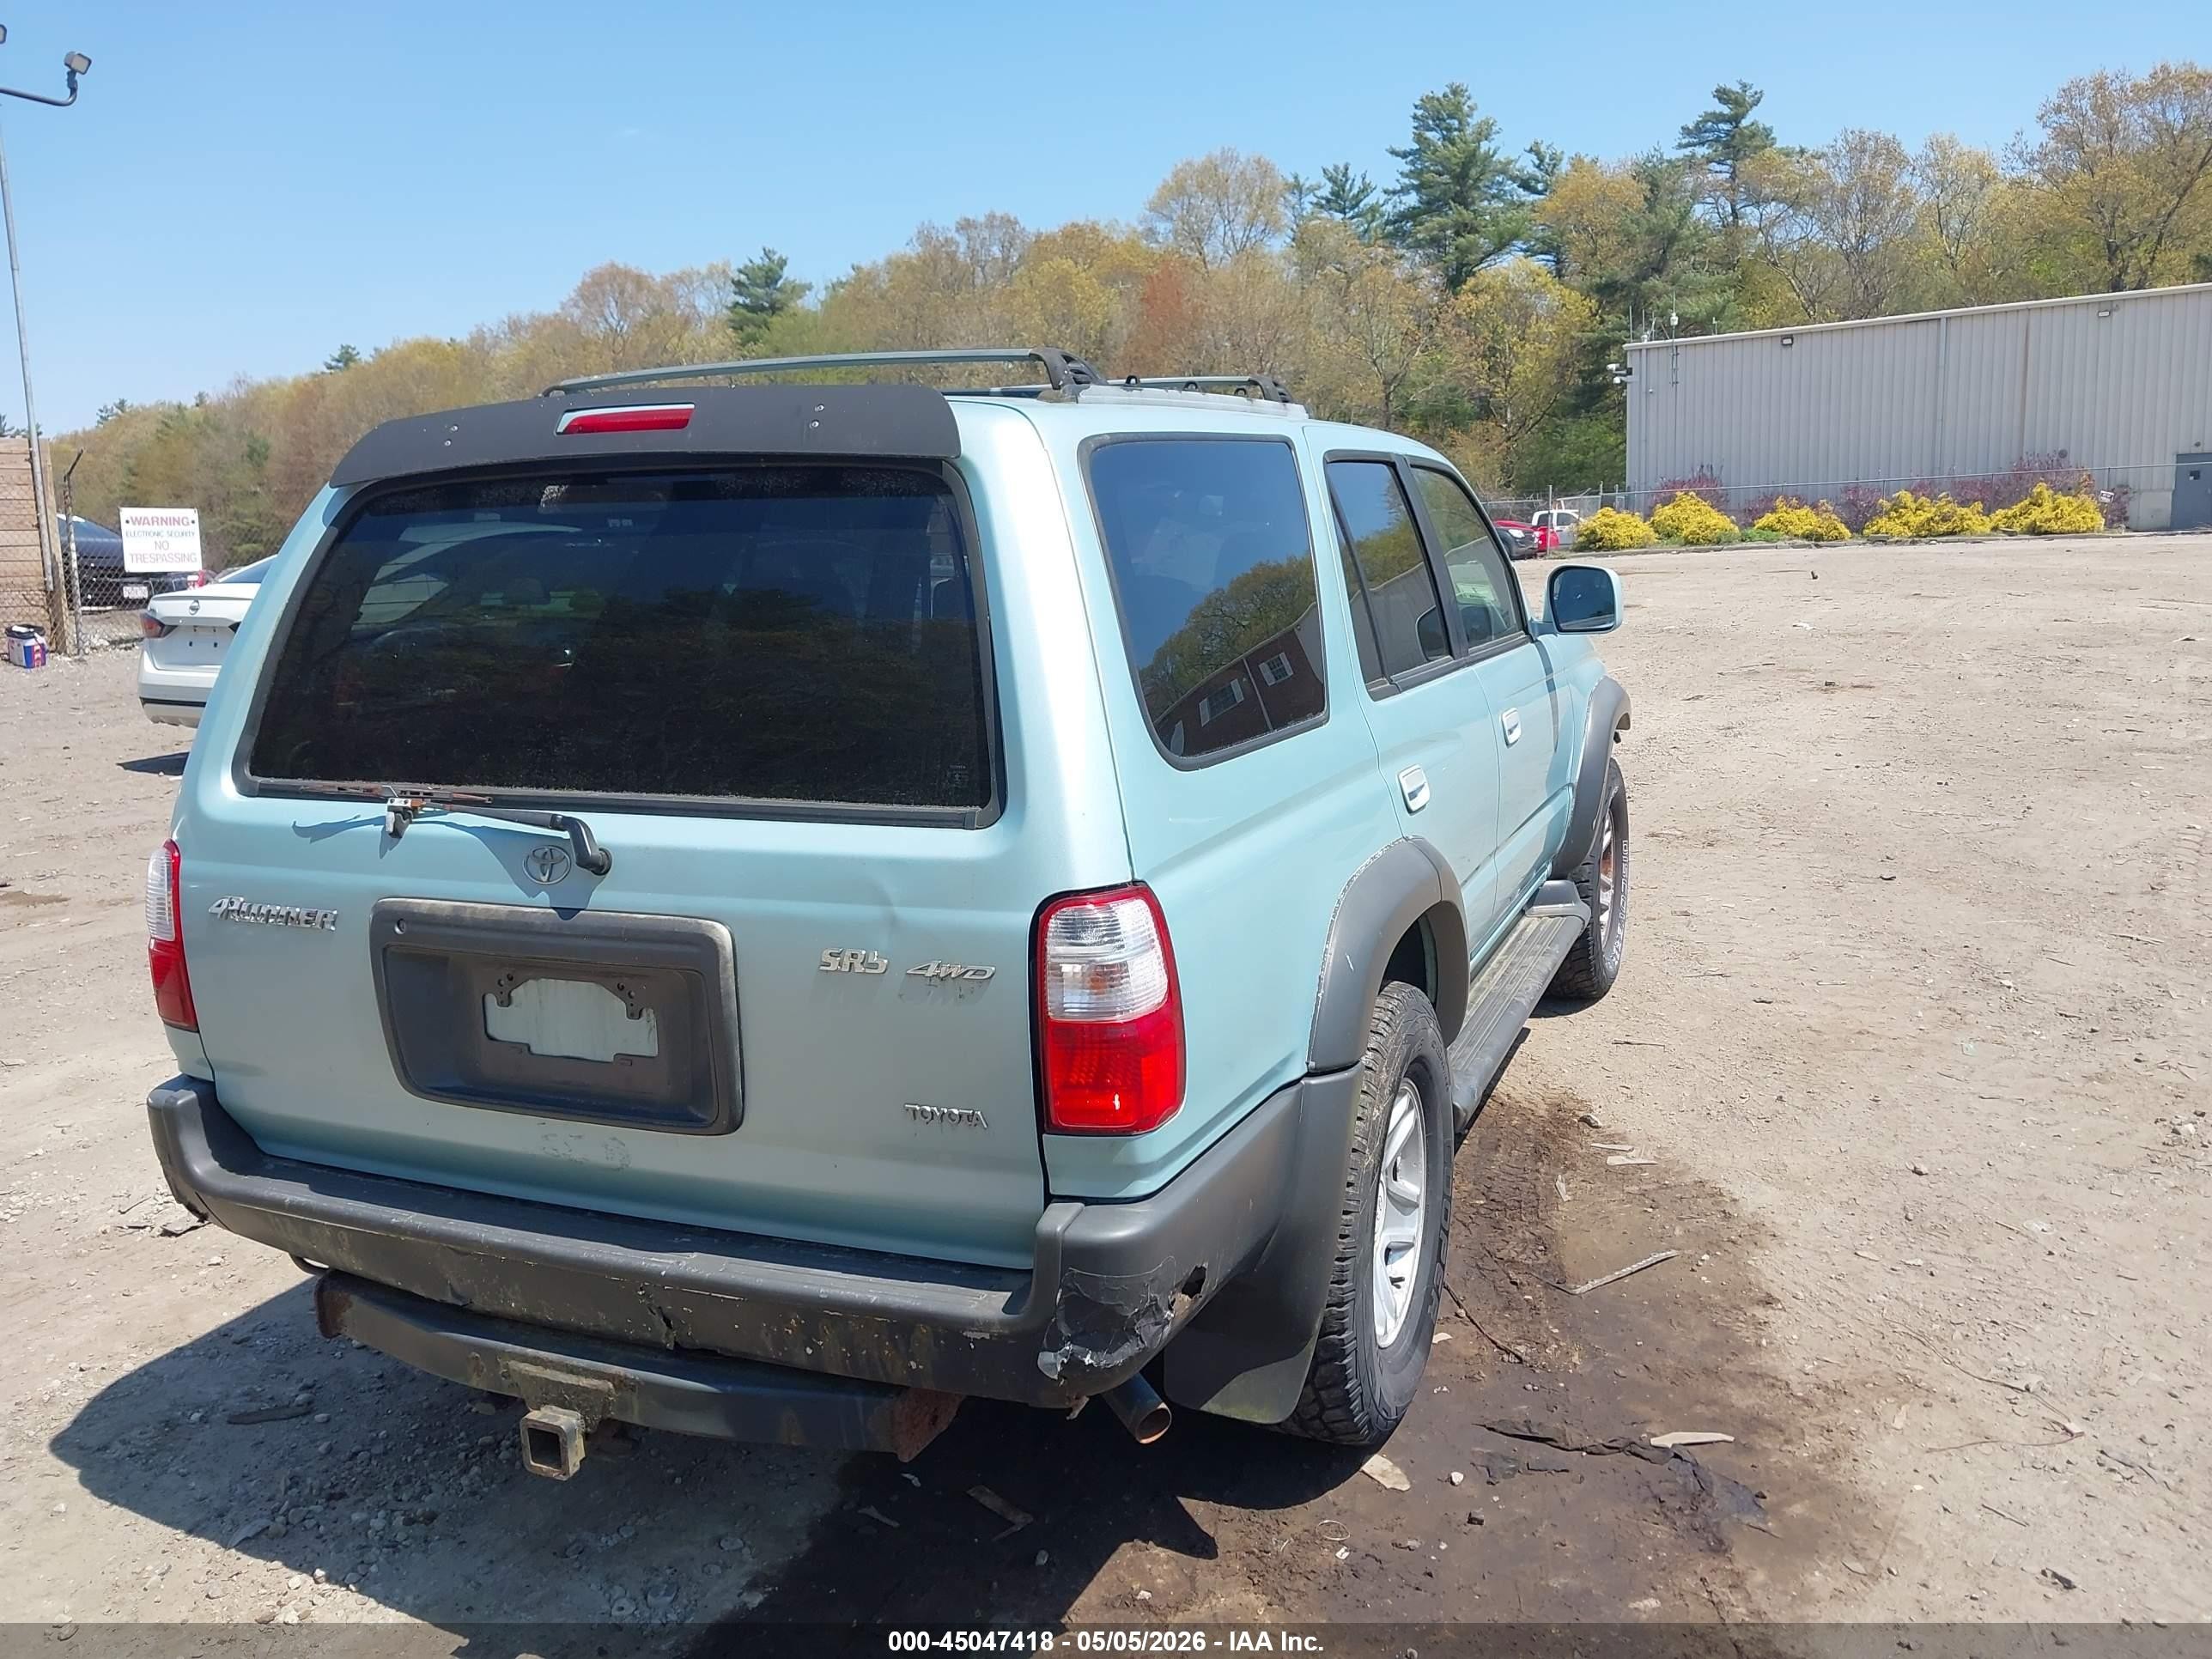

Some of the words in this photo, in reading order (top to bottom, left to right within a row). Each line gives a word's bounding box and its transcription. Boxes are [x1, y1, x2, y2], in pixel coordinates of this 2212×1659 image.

[130, 516, 191, 526] WARNING
[125, 529, 164, 538] ELECTRONIC
[167, 529, 195, 538] SECURITY
[154, 540, 170, 550] NO
[130, 552, 198, 563] TRESPASSING
[819, 947, 888, 974] SR5
[906, 960, 996, 981] 4WD
[904, 1103, 988, 1128] TOYOTA
